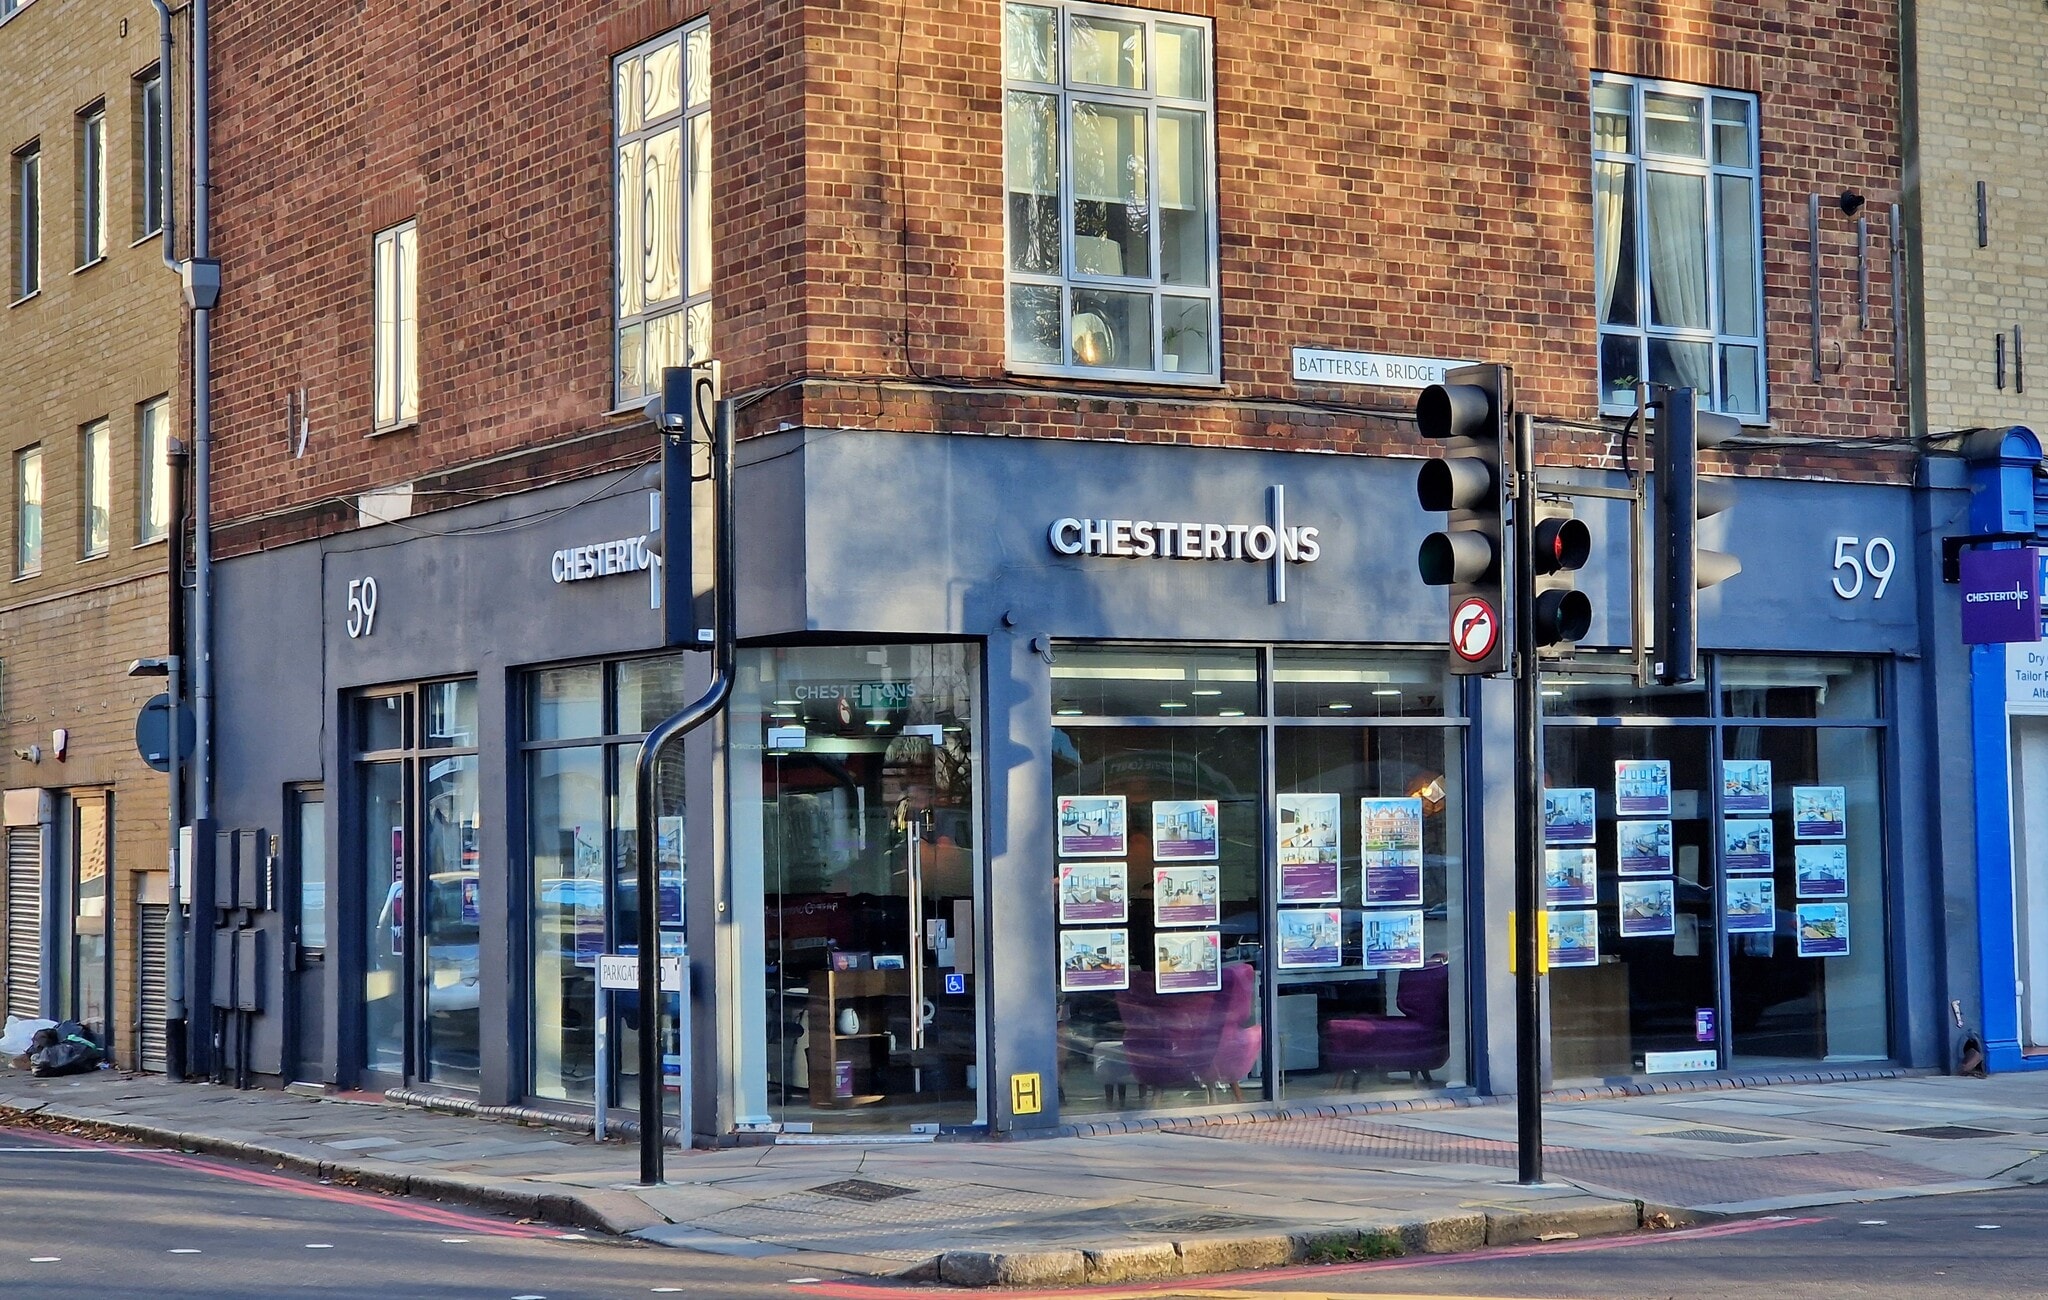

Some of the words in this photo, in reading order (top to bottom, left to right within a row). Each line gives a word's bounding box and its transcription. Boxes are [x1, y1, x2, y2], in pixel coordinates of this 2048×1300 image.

[1300, 356, 1379, 378] BATTERSEA
[1386, 363, 1435, 382] BRIDGE
[1832, 536, 1896, 599] 59
[346, 576, 378, 639] 59
[2028, 652, 2045, 667] Dry
[2015, 669, 2042, 681] Tailor
[603, 964, 639, 981] PARKGAT
